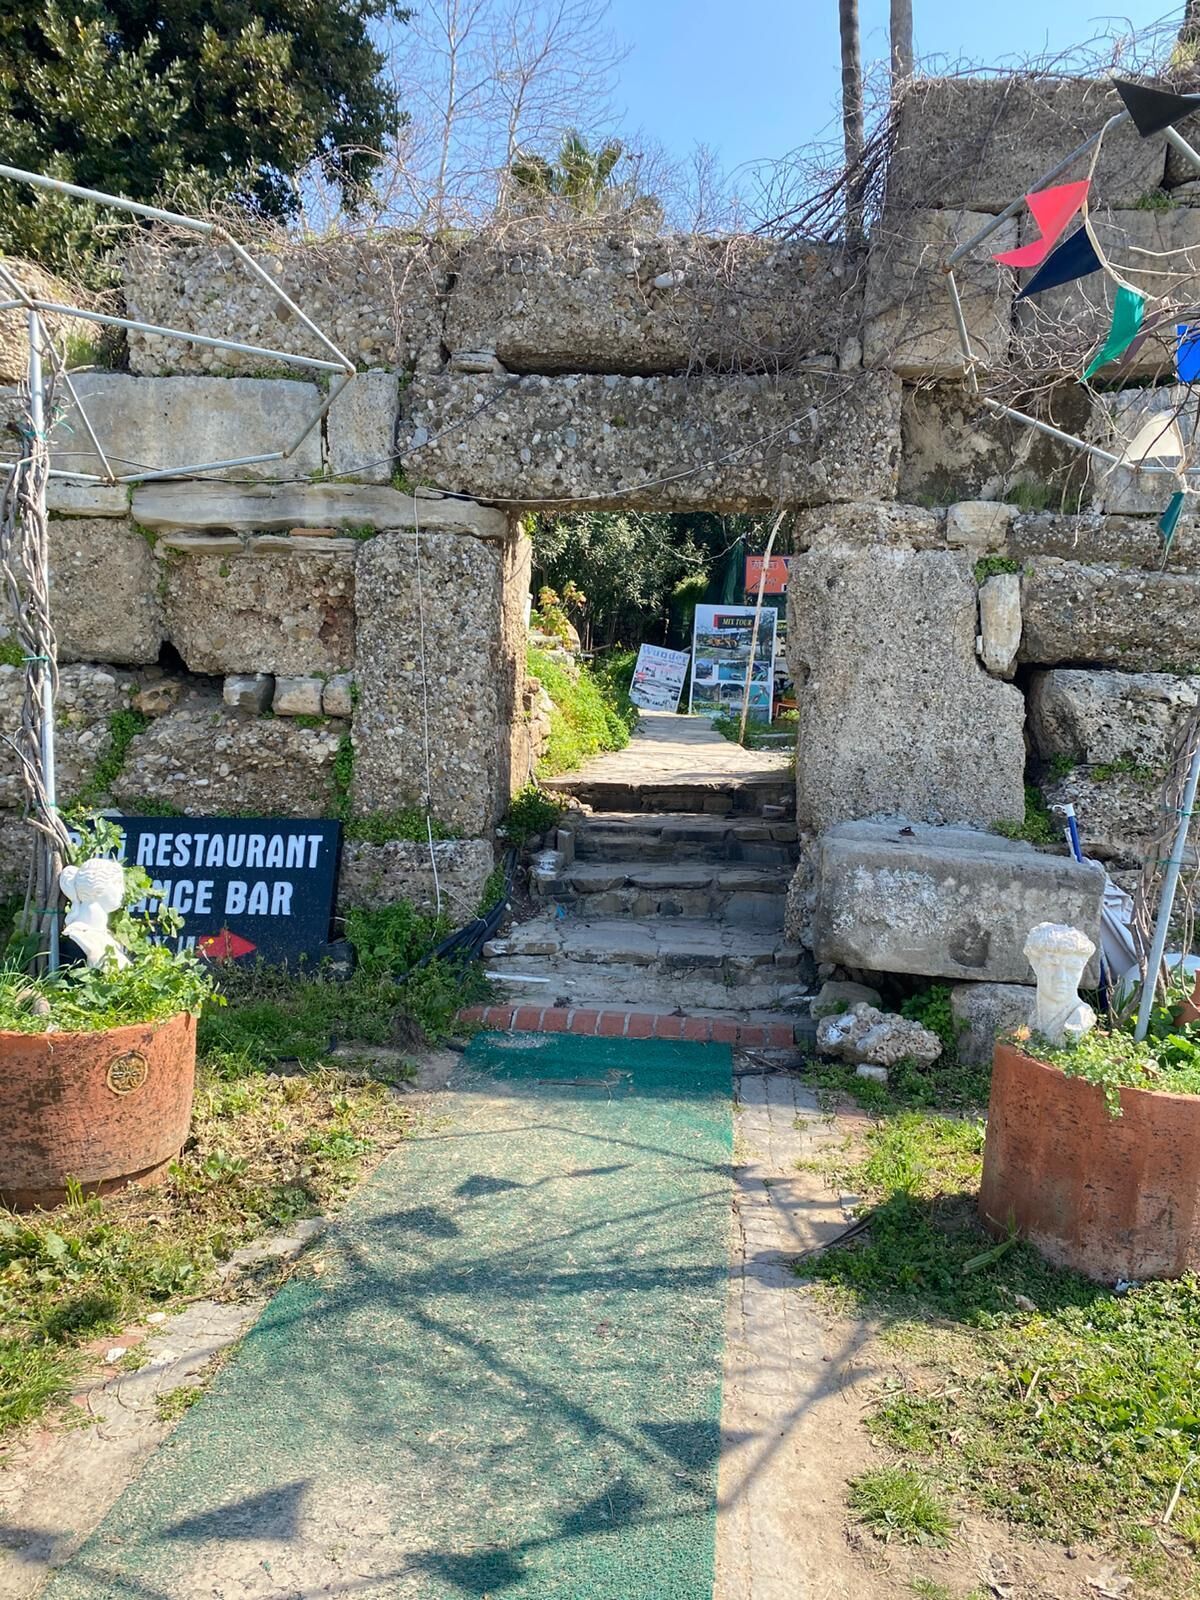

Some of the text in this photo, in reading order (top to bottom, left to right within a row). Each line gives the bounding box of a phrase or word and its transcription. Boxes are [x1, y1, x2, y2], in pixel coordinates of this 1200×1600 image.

[136, 833, 324, 868] RESTAURANT
[128, 879, 294, 915] ANCE BAR
